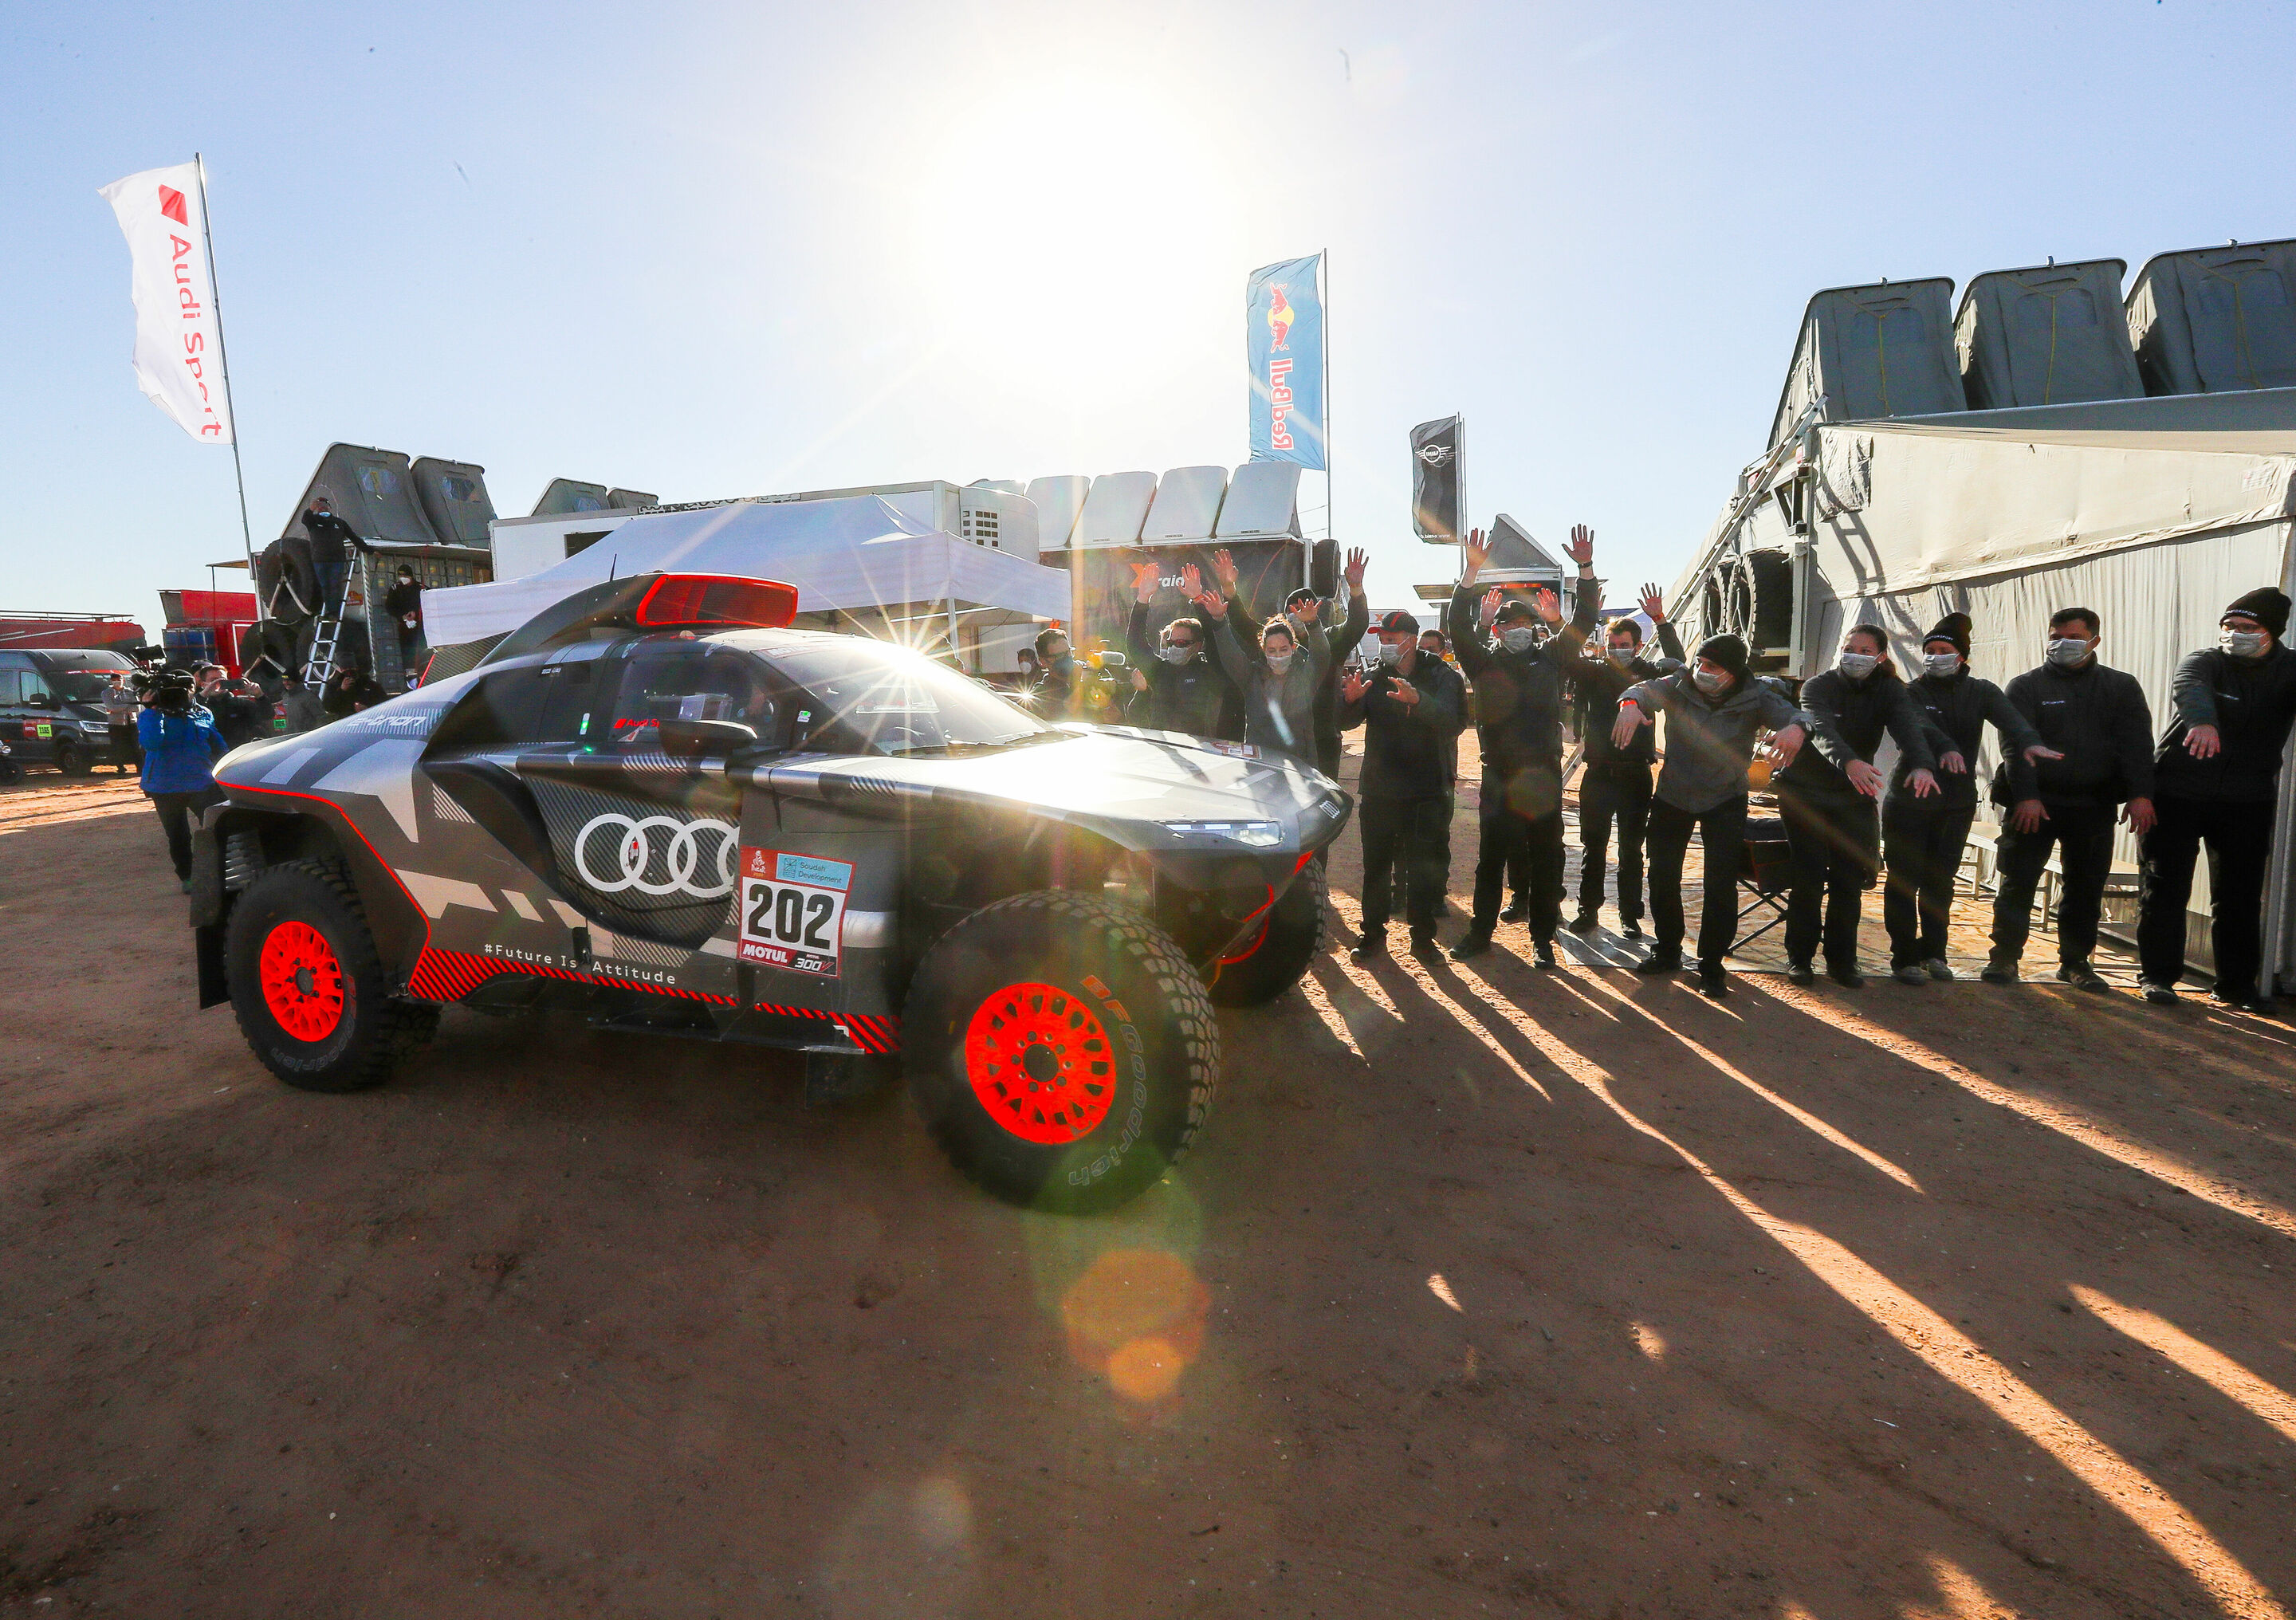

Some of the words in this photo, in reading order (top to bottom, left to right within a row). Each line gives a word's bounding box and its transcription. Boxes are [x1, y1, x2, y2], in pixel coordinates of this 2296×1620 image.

[170, 234, 201, 319] Audi
[798, 871, 843, 884] Development
[800, 862, 826, 871] Soudah
[747, 883, 835, 950] 202
[484, 943, 552, 965] #Future
[561, 955, 578, 969] Is
[592, 961, 676, 985] Attitude
[742, 943, 788, 963] MOTUL
